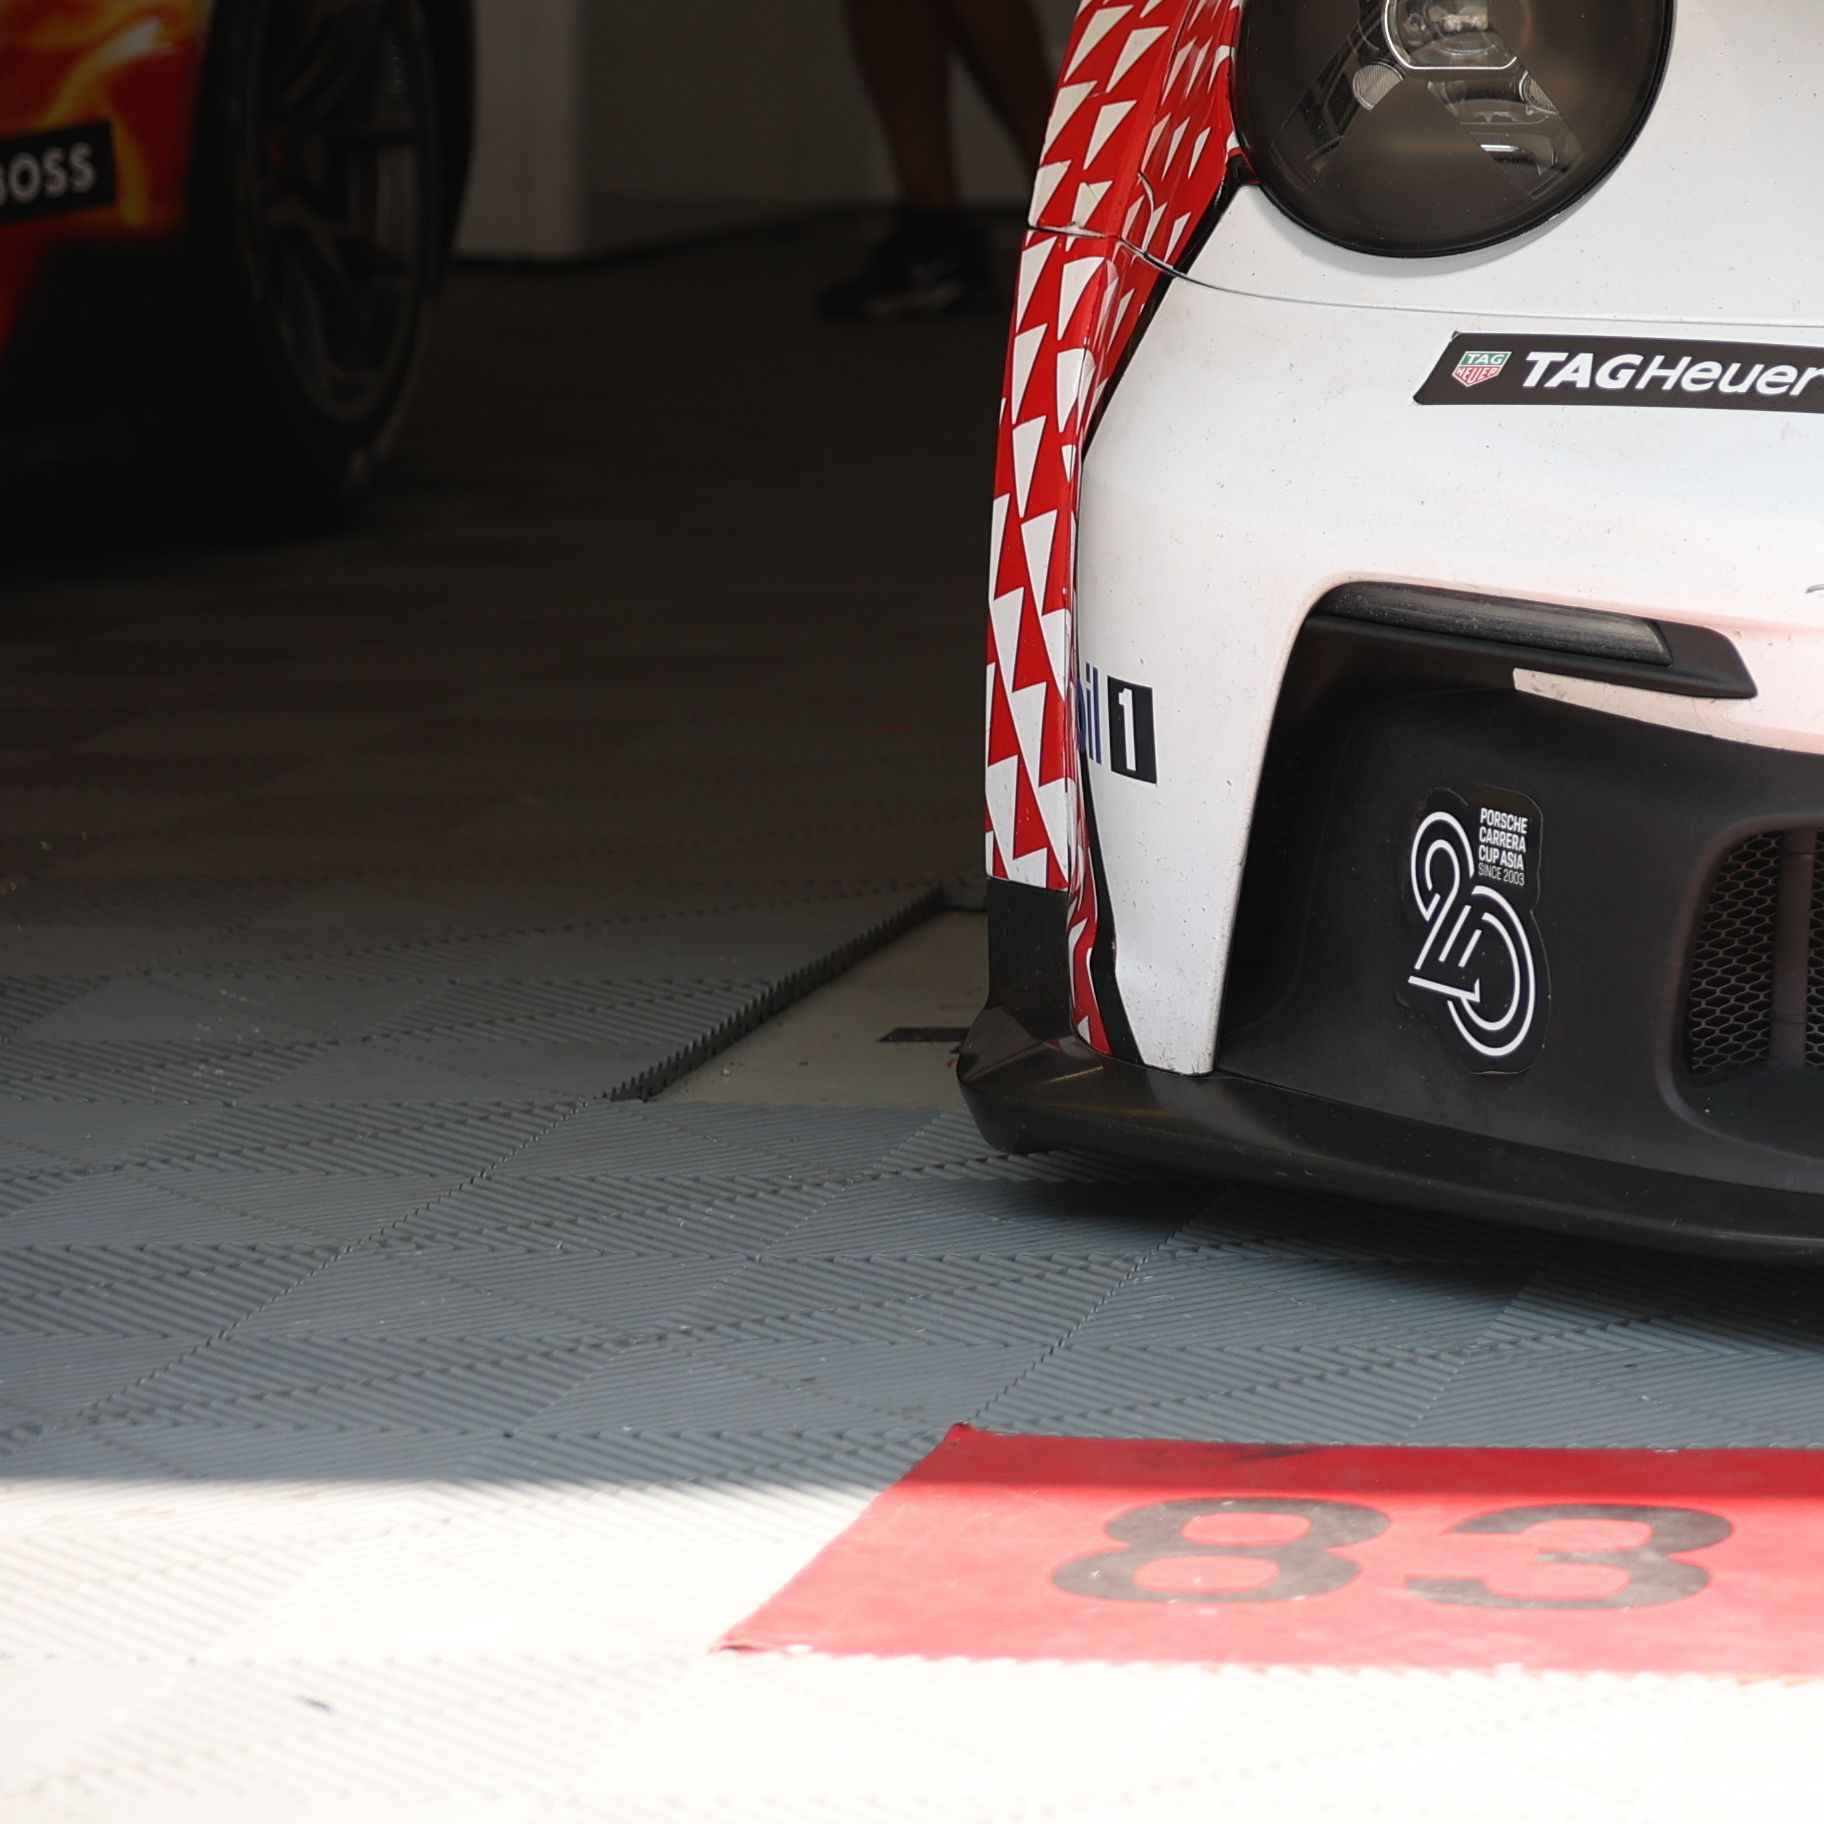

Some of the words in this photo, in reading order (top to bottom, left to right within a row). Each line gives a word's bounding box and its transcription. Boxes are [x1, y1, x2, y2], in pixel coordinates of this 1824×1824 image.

[0, 141, 97, 207] OSS
[1466, 353, 1506, 366] TAG
[1456, 366, 1498, 386] HEUER
[1480, 807, 1528, 834] PORSCHE
[1479, 826, 1527, 853] CARRERA
[1478, 844, 1500, 864] CUP
[1500, 850, 1524, 871] ASIA
[1478, 862, 1502, 880] SINCE
[1503, 868, 1525, 886] 2003
[1050, 1495, 1735, 1611] 83
